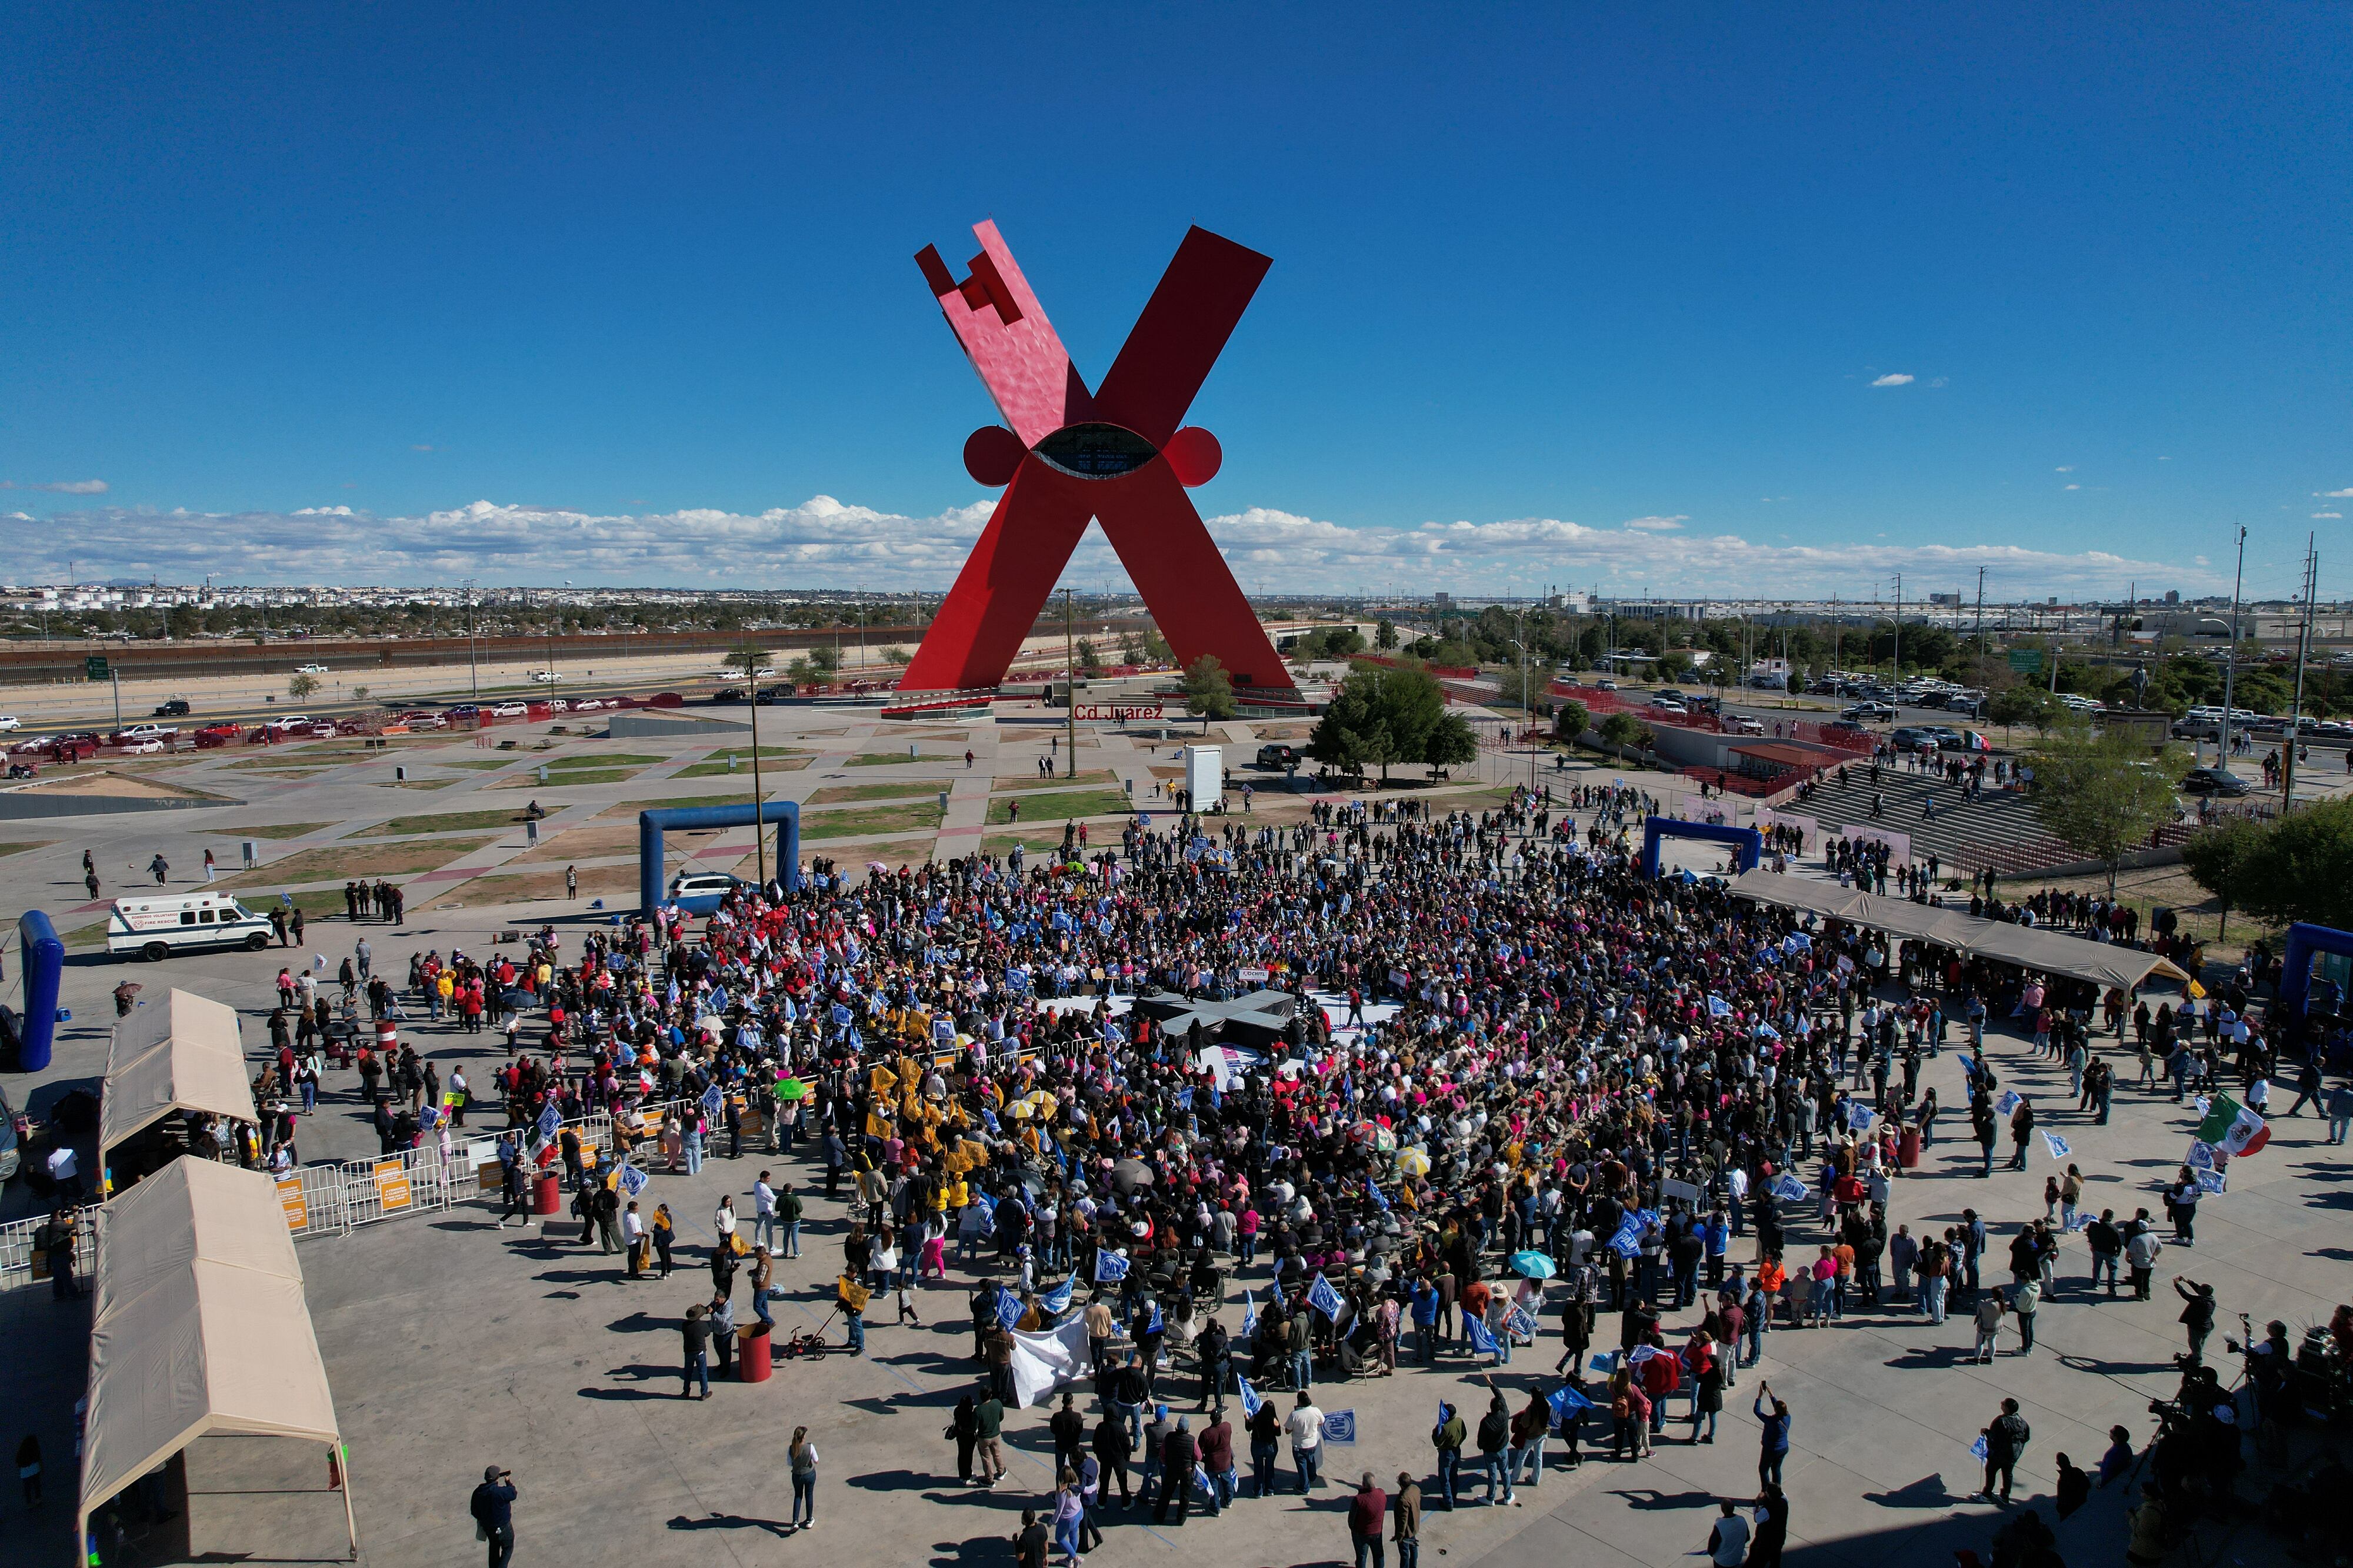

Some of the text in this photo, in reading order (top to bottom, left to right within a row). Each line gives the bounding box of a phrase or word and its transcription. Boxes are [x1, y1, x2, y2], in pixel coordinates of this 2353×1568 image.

[1074, 703, 1164, 720] Cd. Juárez
[423, 1112, 435, 1124] PAN
[1620, 1234, 1637, 1251] PAN
[1329, 1417, 1346, 1435] PAN
